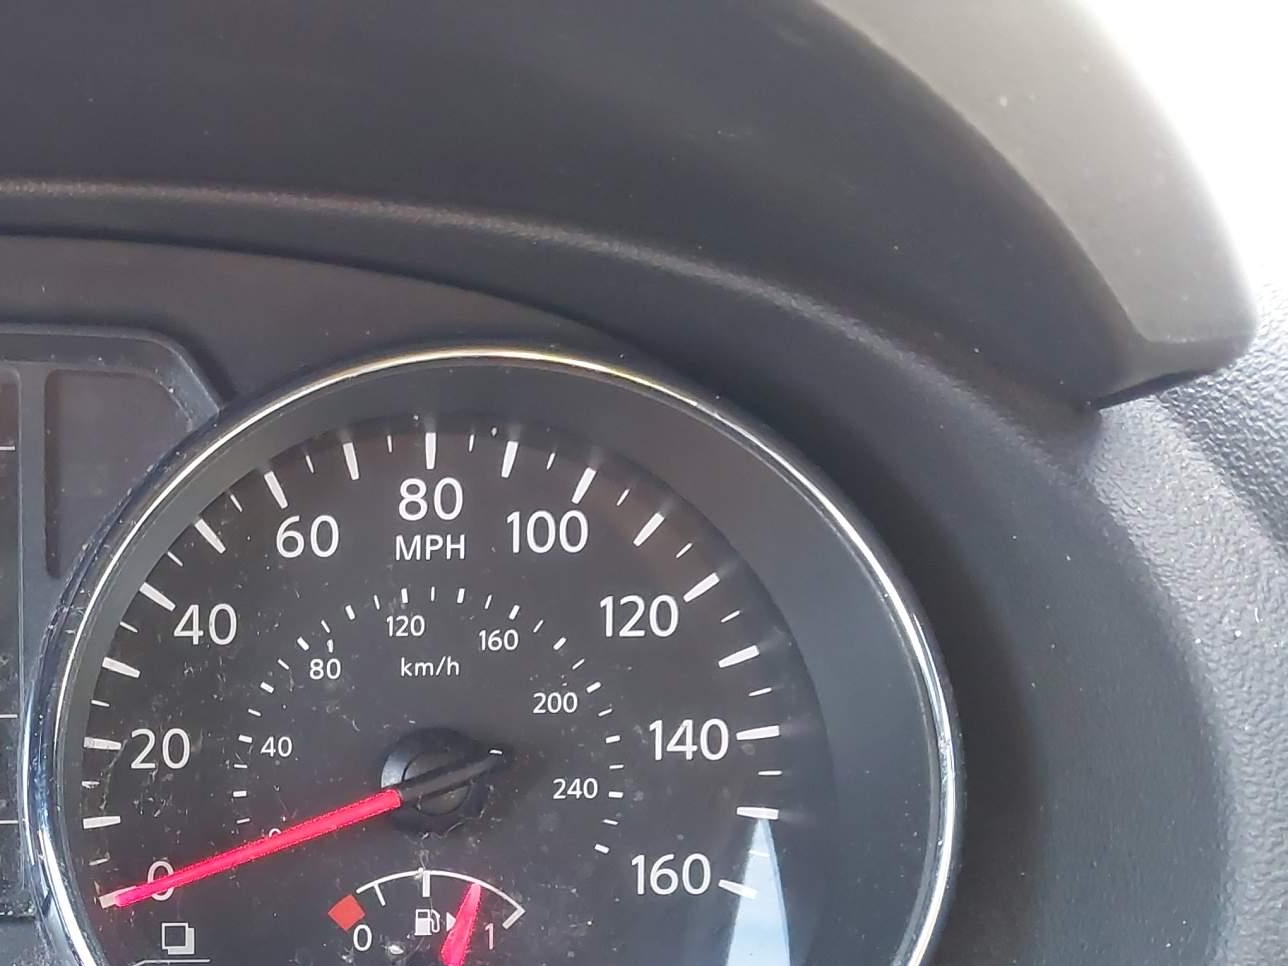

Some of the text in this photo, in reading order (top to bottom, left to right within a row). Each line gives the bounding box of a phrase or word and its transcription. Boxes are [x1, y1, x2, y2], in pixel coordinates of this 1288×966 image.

[398, 477, 463, 521] 80
[276, 514, 339, 558] 60
[506, 509, 588, 554] 100
[395, 534, 465, 561] MPH
[173, 602, 238, 645] 40
[386, 614, 425, 637] 120
[599, 594, 679, 637] 120
[478, 629, 519, 651] 160
[309, 658, 341, 680] 80
[400, 655, 460, 677] km/h
[532, 691, 578, 714] 200
[130, 728, 190, 769] 20
[260, 736, 293, 757] 40
[649, 718, 729, 761] 140
[553, 777, 598, 800] 240
[631, 853, 711, 895] 160
[353, 925, 373, 952] 0
